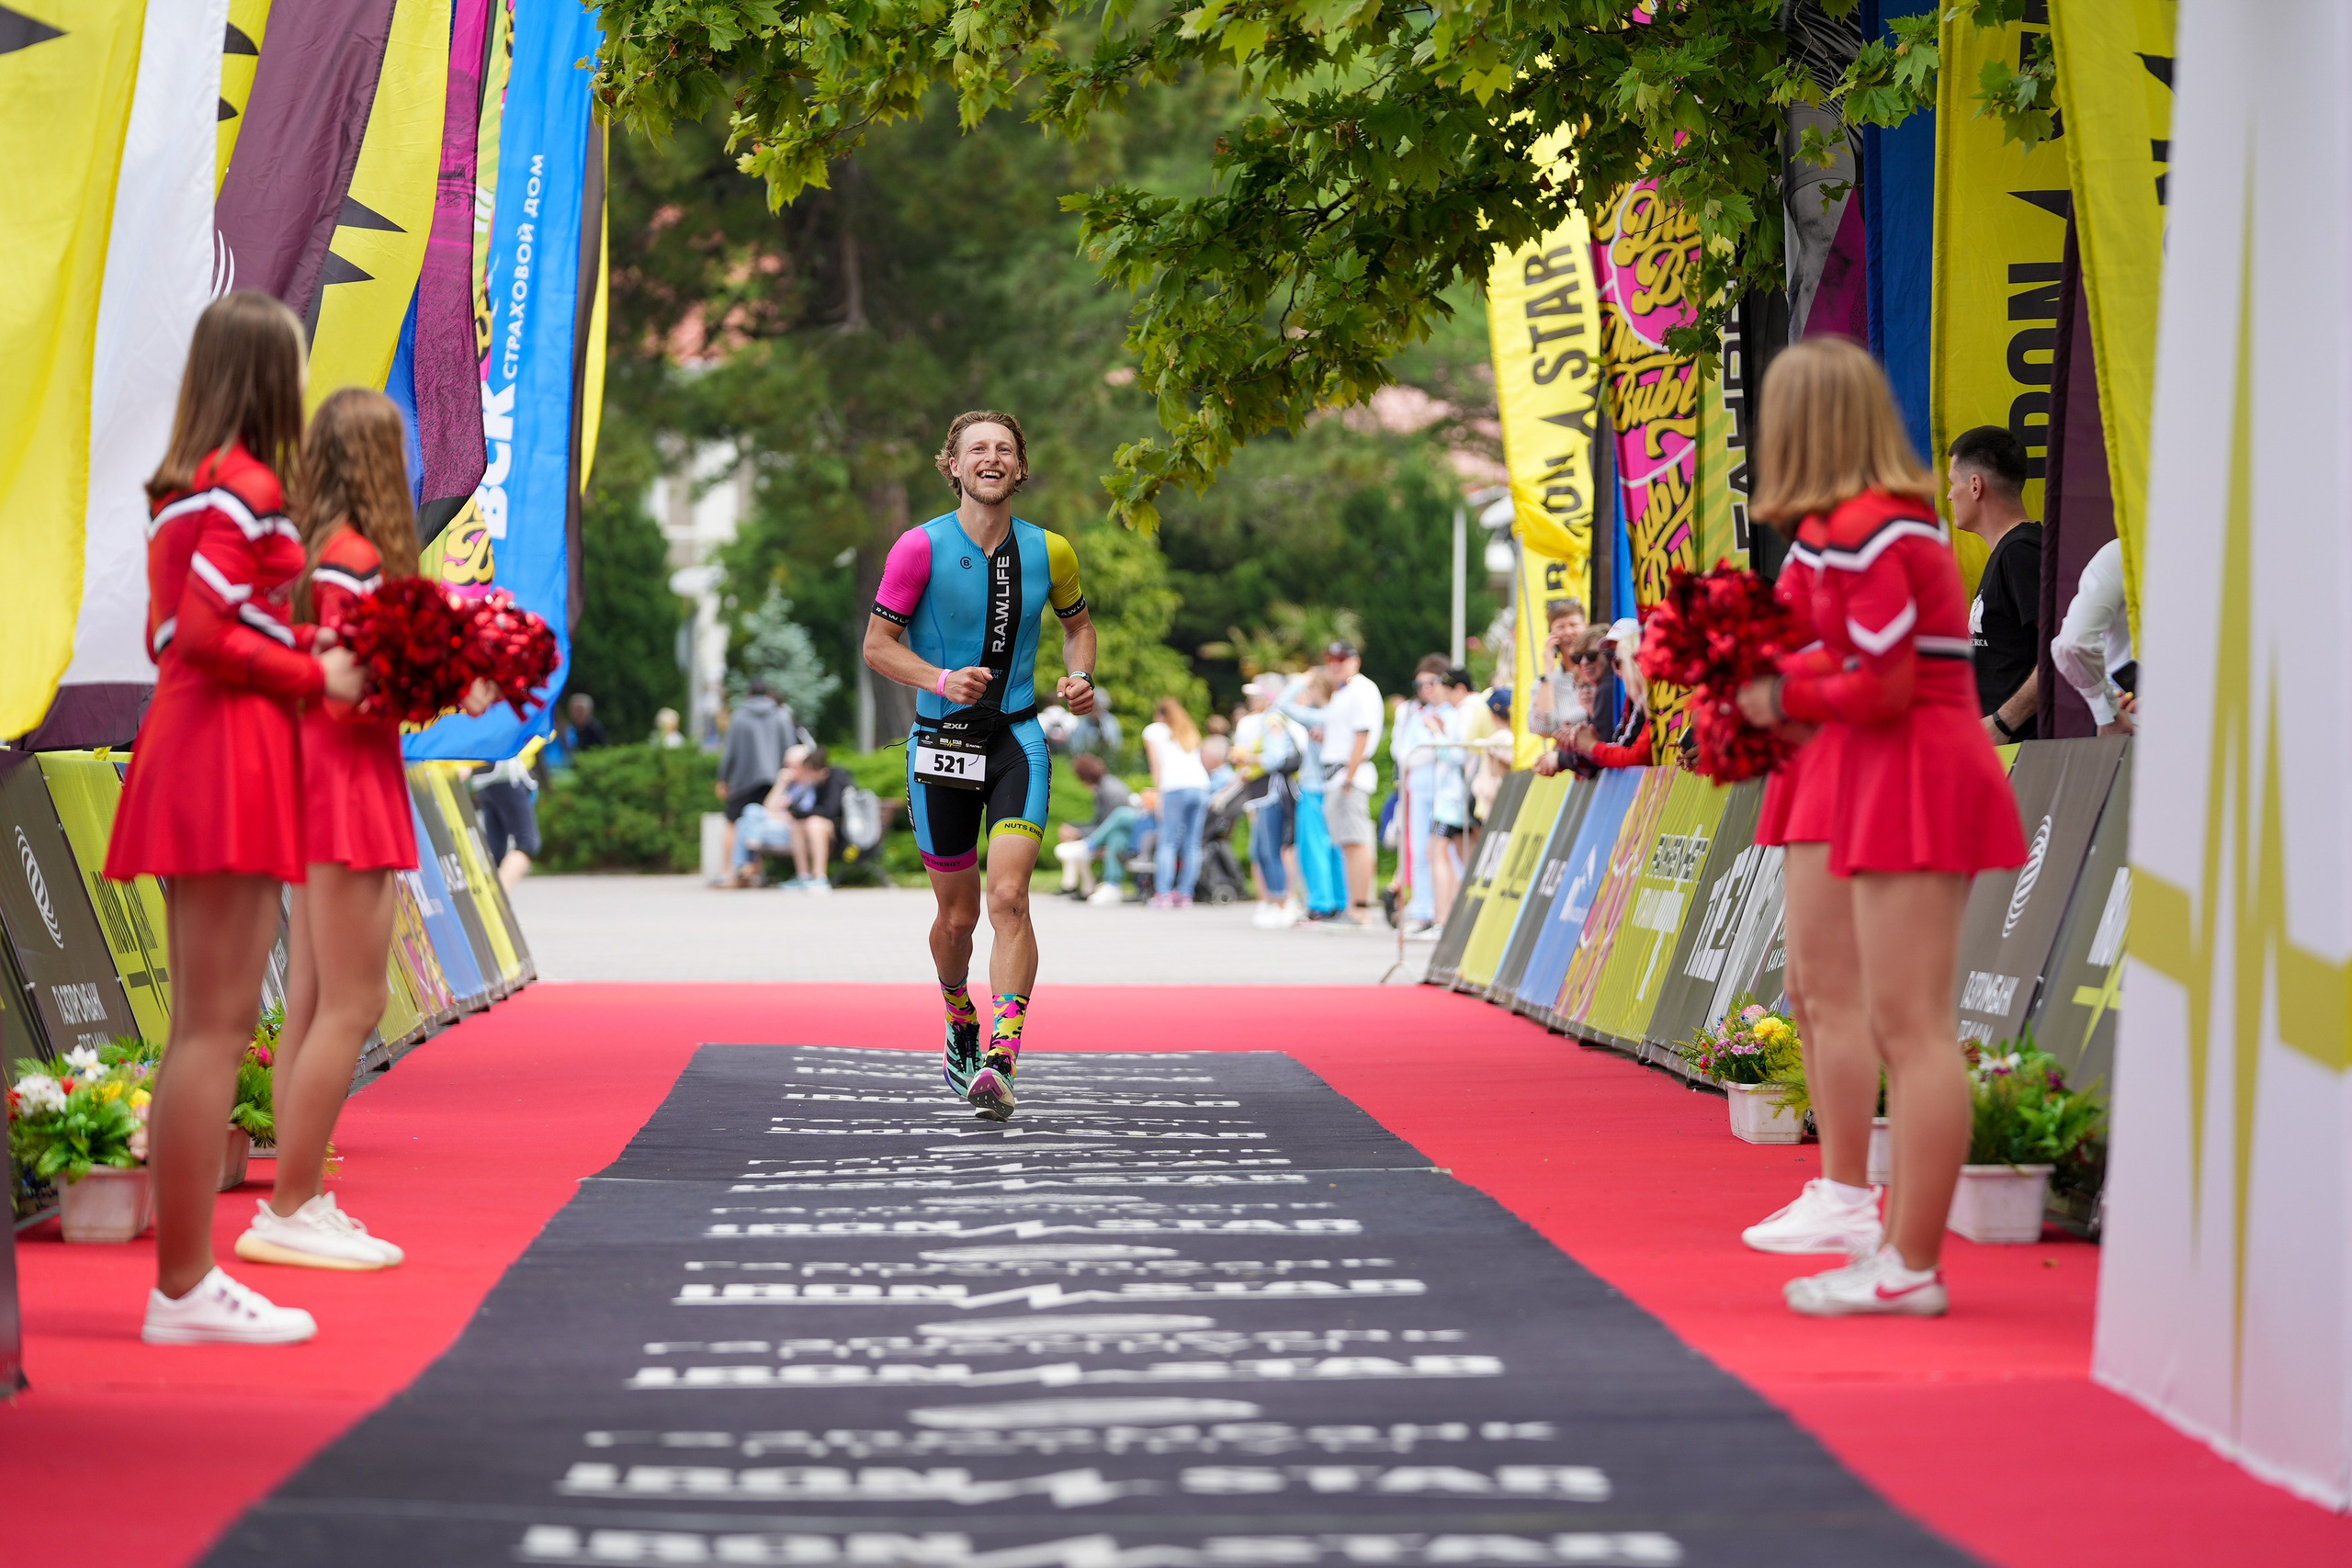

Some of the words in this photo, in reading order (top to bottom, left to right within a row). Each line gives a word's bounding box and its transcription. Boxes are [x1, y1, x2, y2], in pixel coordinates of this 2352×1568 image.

[502, 223, 535, 380] СТРАХОВОЙ
[524, 152, 545, 218] ДОМ
[1524, 243, 1589, 386] STAR
[991, 555, 1010, 653] R.A.W.LIFE
[942, 722, 968, 730] 2XU
[933, 753, 965, 774] 521
[931, 859, 962, 867] ENERGY
[51, 981, 108, 1026] ГАЗПРОМБАНК
[1064, 1129, 1267, 1138] STAR
[741, 1166, 955, 1177] IRON
[1072, 1175, 1308, 1183] STAR
[708, 1220, 962, 1233] IRON
[1096, 1219, 1363, 1231] STAR
[679, 1283, 970, 1298] IRON
[1120, 1279, 1427, 1295] STAR
[634, 1363, 973, 1387] IRON
[1147, 1355, 1503, 1379] STAR
[562, 1461, 971, 1494] IRON
[1179, 1464, 1611, 1498] STAR
